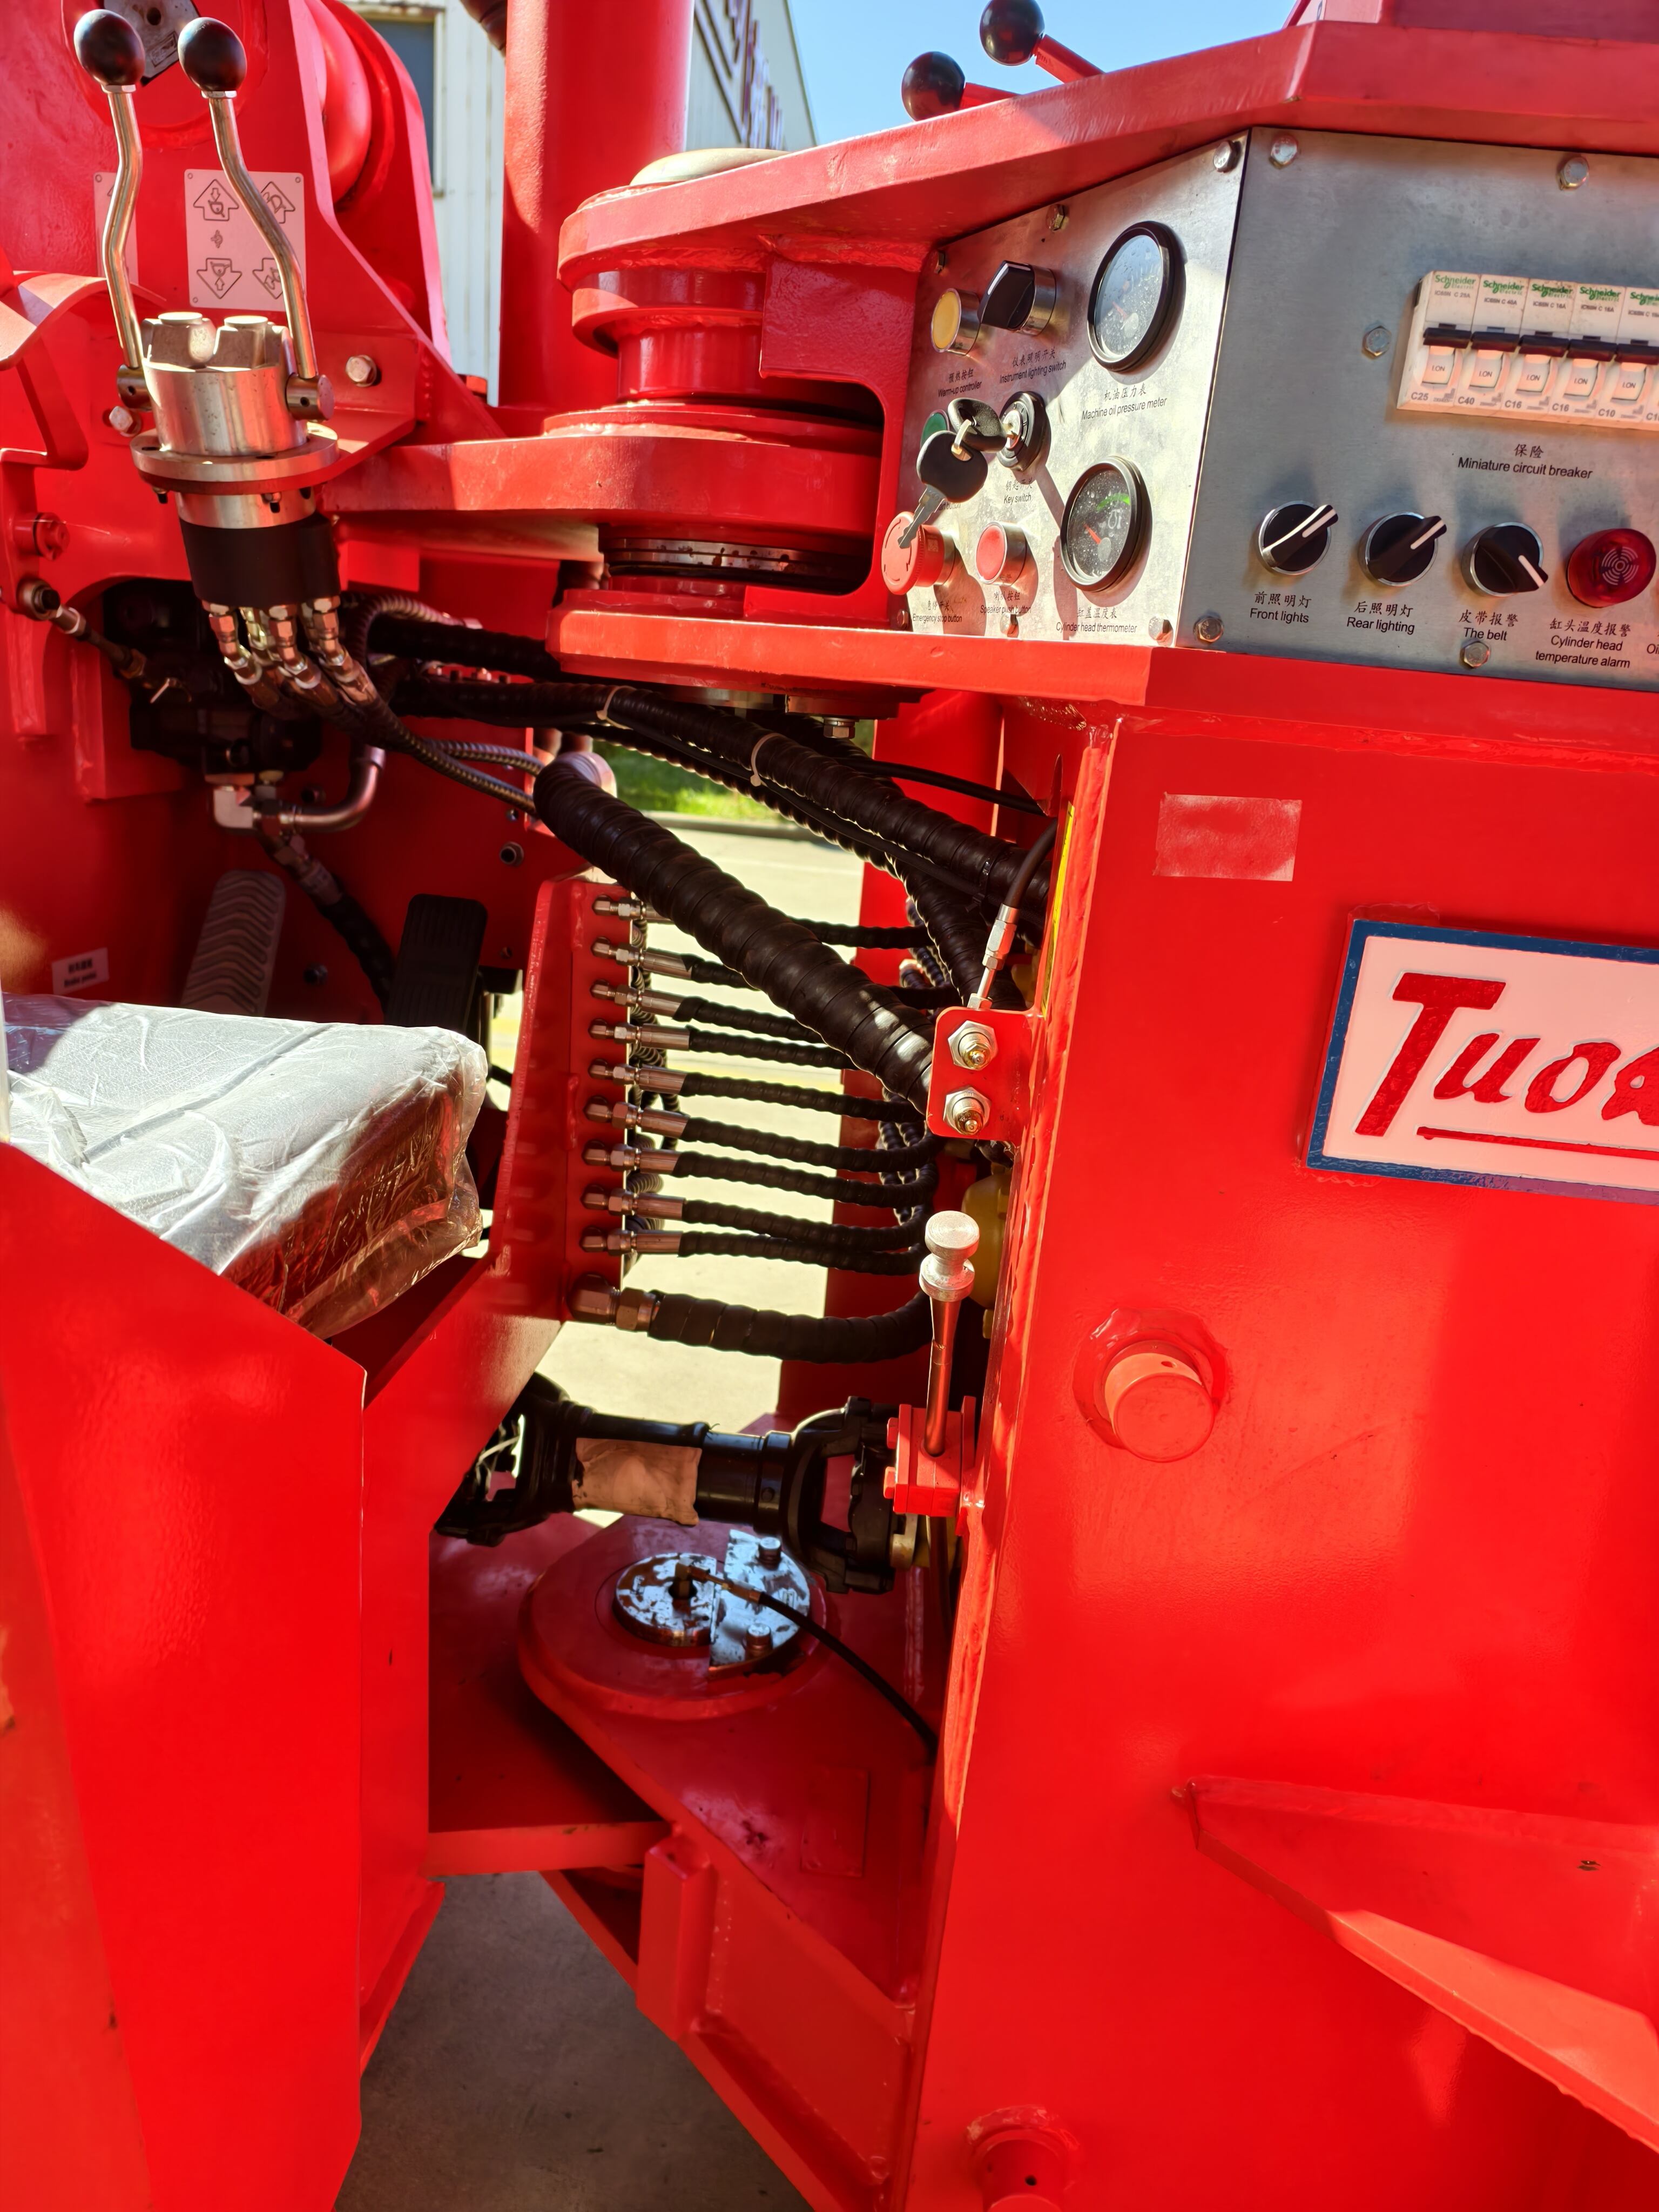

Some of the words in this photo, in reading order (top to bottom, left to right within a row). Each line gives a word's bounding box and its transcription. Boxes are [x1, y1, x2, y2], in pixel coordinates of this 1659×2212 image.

[1435, 274, 1476, 289] Schneider
[1483, 280, 1525, 294] Schneider
[1532, 283, 1573, 298] Schneider
[1580, 286, 1621, 300] Schneider
[1012, 348, 1056, 367] 仪表照明开关
[999, 370, 1027, 384] Instrument
[1028, 366, 1047, 379] lighting
[1048, 360, 1066, 373] switch
[938, 386, 959, 397] Warm-up
[959, 381, 982, 394] controller
[1104, 383, 1147, 402] 机油压力表
[1411, 392, 1429, 401] C25
[1458, 396, 1475, 405] C40
[1505, 400, 1522, 409] C16
[1552, 403, 1569, 412] C16
[1082, 408, 1107, 420] Machine
[1117, 402, 1145, 416] pressure
[1147, 397, 1167, 409] meter
[1599, 408, 1616, 417] C10
[1646, 413, 1659, 421] C1
[1514, 444, 1544, 458] 保险
[1458, 457, 1510, 472] Miniature
[1513, 462, 1547, 476] circuit
[1549, 465, 1593, 479] breaker
[1004, 495, 1014, 505] Key
[1015, 493, 1031, 503] switch
[1255, 591, 1312, 609] 前照明灯
[980, 605, 1001, 615] Speaker
[1002, 606, 1014, 615] push
[1015, 606, 1031, 614] button
[1077, 606, 1117, 619] 缸盖温度表
[1250, 608, 1278, 620] Front
[1280, 611, 1309, 624] lights
[1354, 601, 1414, 618] 后照明灯
[913, 613, 937, 623] Emergency
[938, 615, 947, 623] stop
[1459, 609, 1518, 627] 皮带报警
[1056, 622, 1080, 633] Cylinder
[1081, 623, 1096, 632] head
[1097, 623, 1137, 633] thermometer
[1347, 617, 1374, 629] Rear
[1376, 619, 1415, 635] lighting
[1549, 618, 1631, 637] 缸头温度报警
[1464, 627, 1484, 638] The
[1487, 629, 1507, 641] belt
[1551, 635, 1594, 648] Cylinder
[1596, 639, 1623, 651] head
[1536, 651, 1599, 665] temperature
[1601, 657, 1630, 669] alarm
